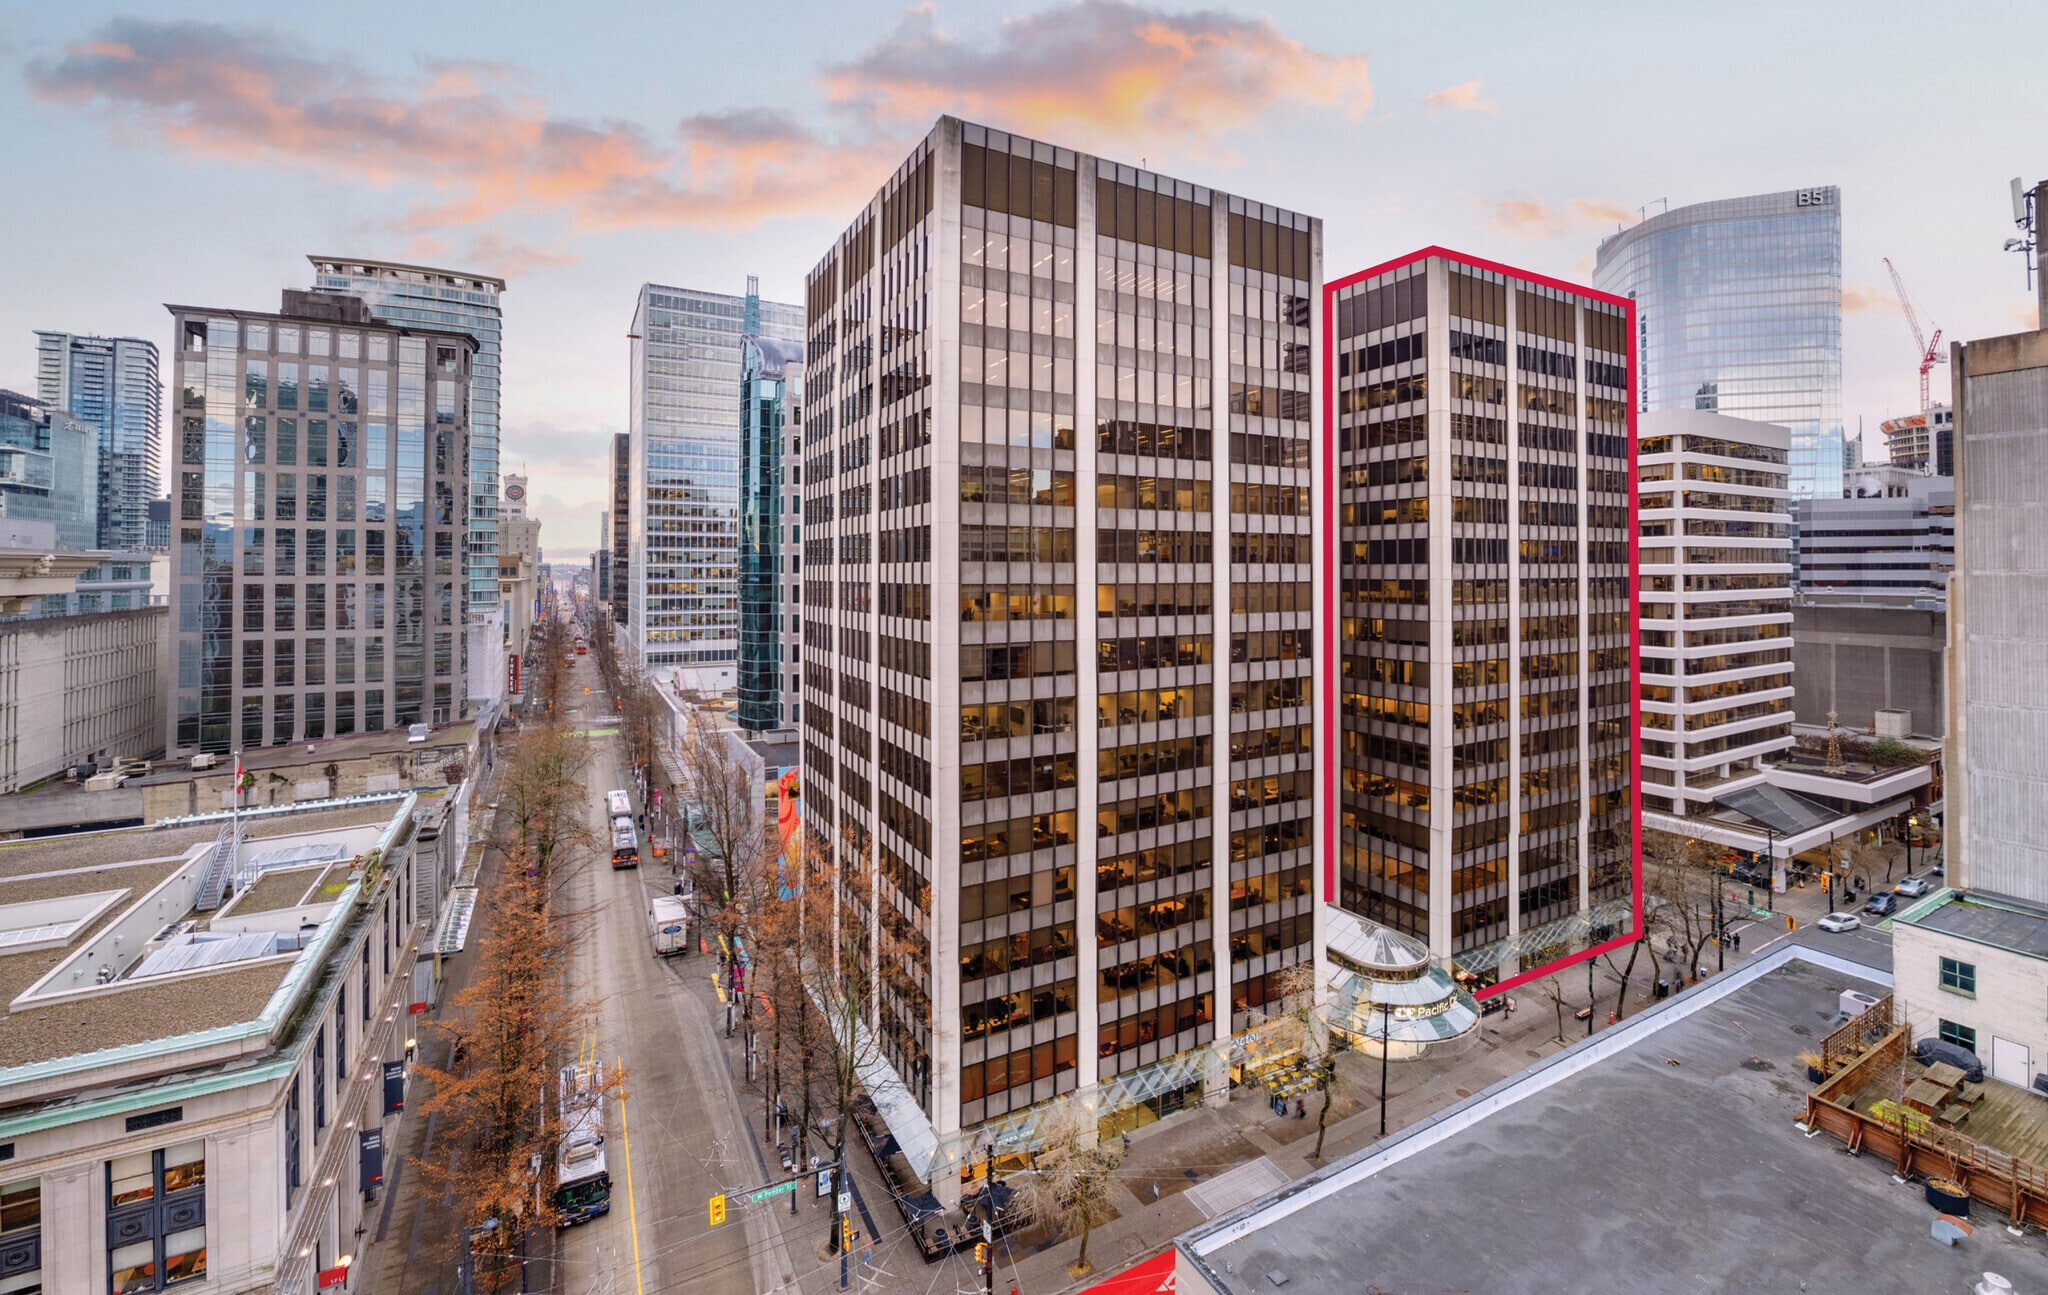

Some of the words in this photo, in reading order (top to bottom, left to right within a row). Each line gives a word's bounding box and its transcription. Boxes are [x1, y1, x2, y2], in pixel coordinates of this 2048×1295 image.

[1798, 191, 1824, 207] B5
[1394, 1007, 1416, 1018] CF
[1417, 1001, 1449, 1017] Pacific
[329, 1275, 345, 1285] SFU
